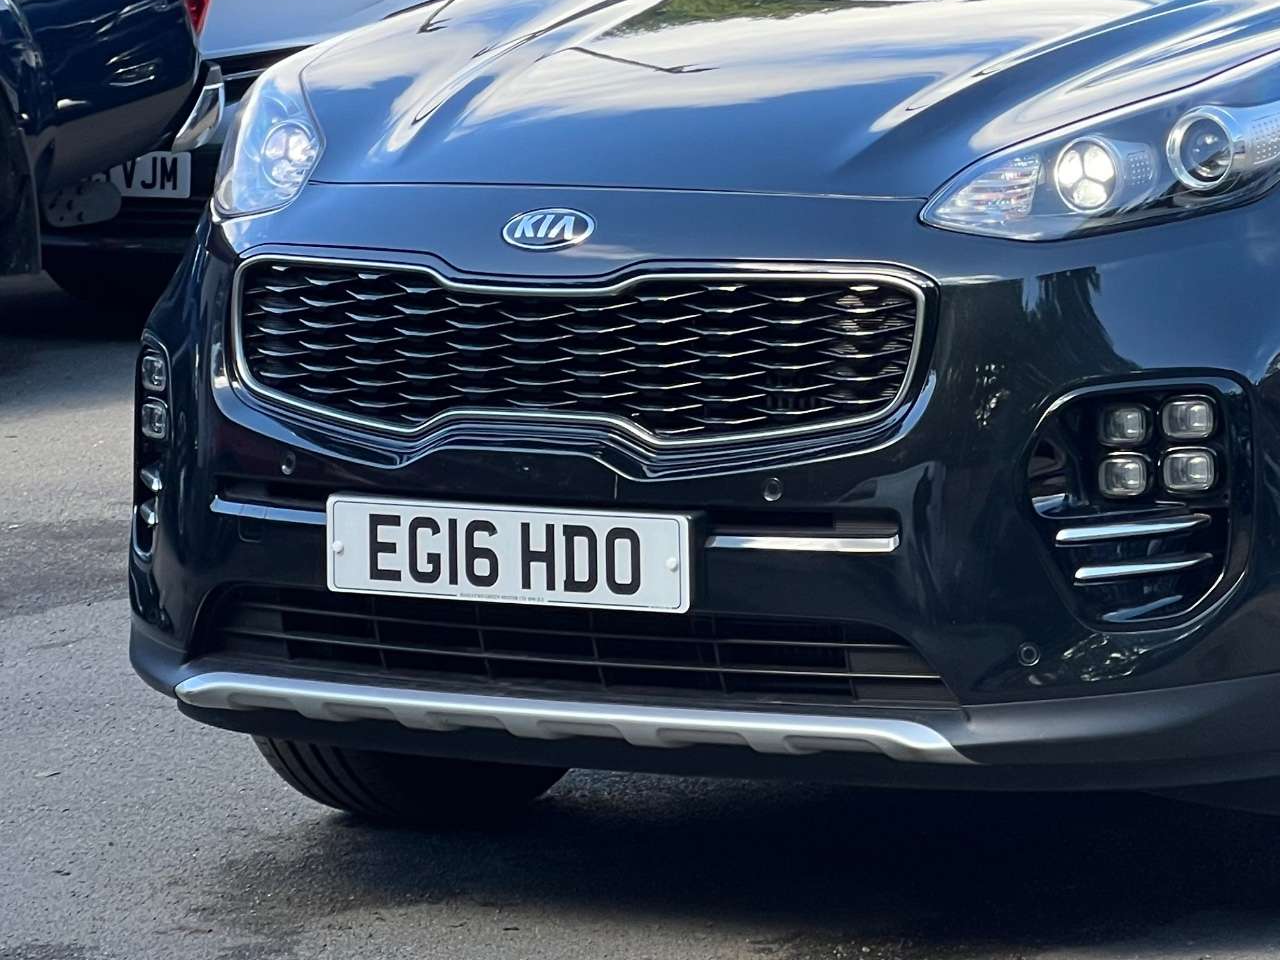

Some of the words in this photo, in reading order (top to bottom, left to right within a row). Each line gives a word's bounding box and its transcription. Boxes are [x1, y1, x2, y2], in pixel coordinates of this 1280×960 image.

[121, 156, 178, 191] VJM
[513, 214, 576, 240] KIA
[368, 513, 499, 588] EG16
[521, 521, 641, 595] HDO
